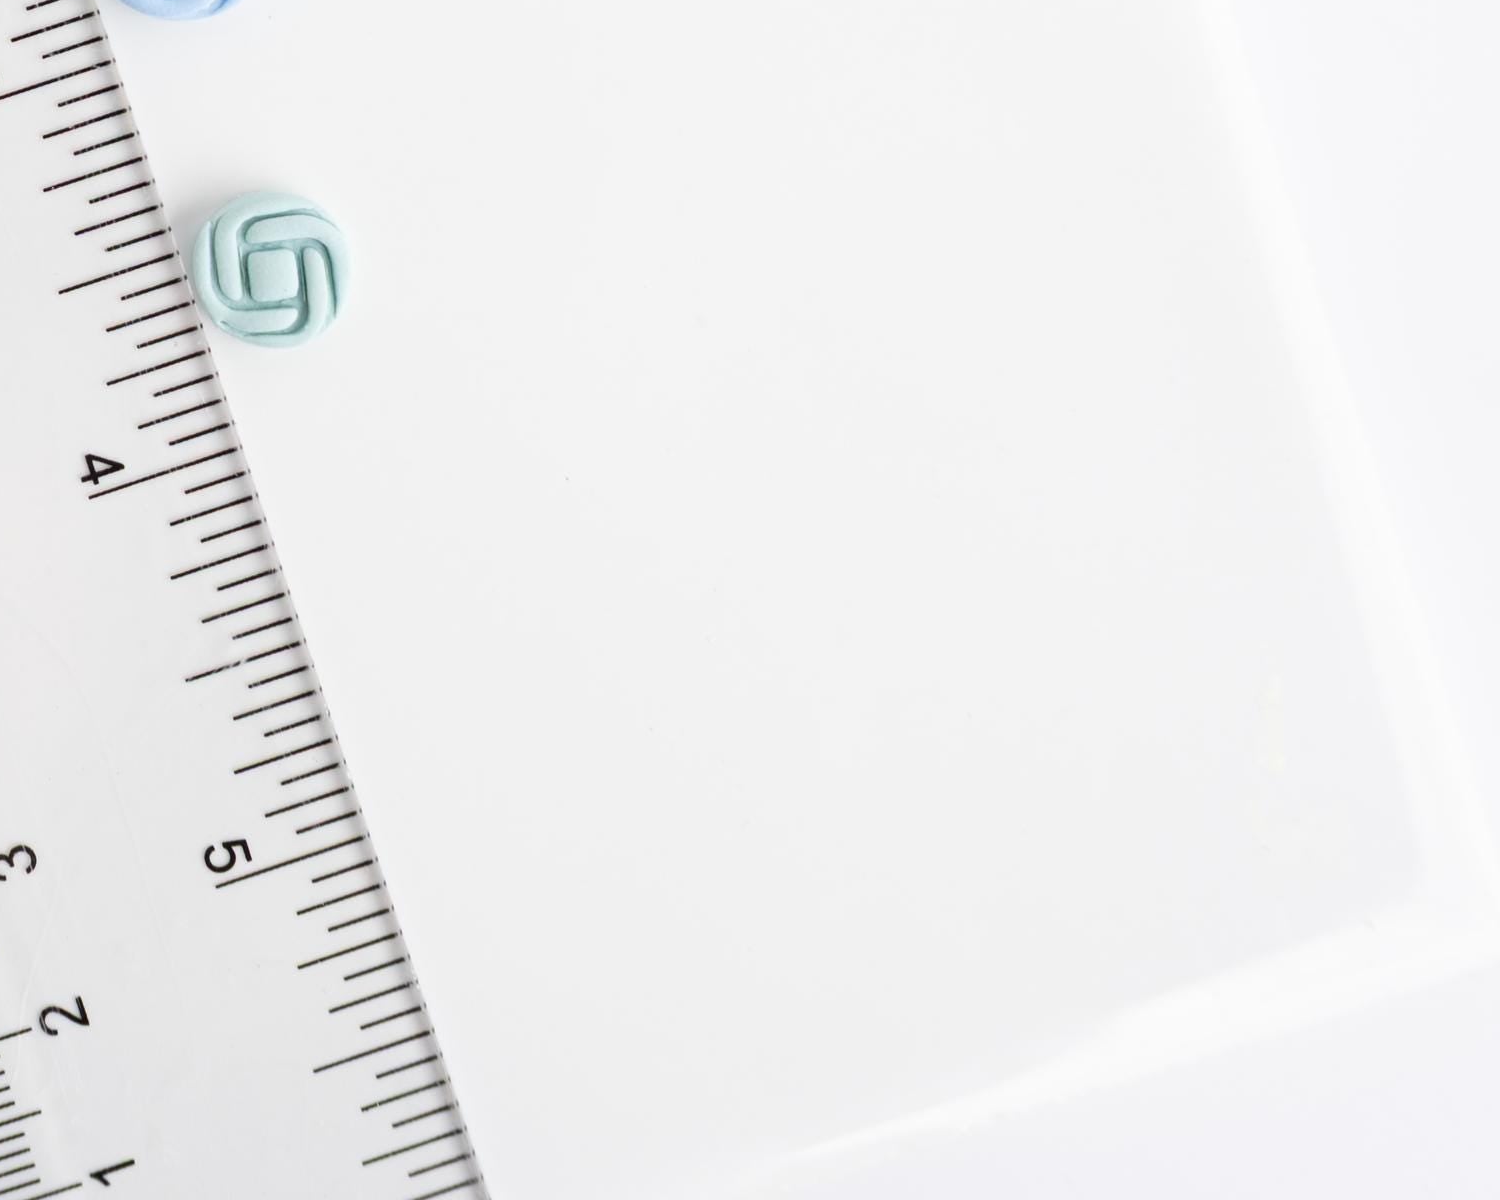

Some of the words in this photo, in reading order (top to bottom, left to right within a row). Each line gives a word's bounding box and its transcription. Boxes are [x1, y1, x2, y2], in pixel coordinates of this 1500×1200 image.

[79, 453, 125, 486] 4
[203, 838, 253, 874] 5
[38, 996, 90, 1036] 2
[89, 1159, 136, 1187] 1
